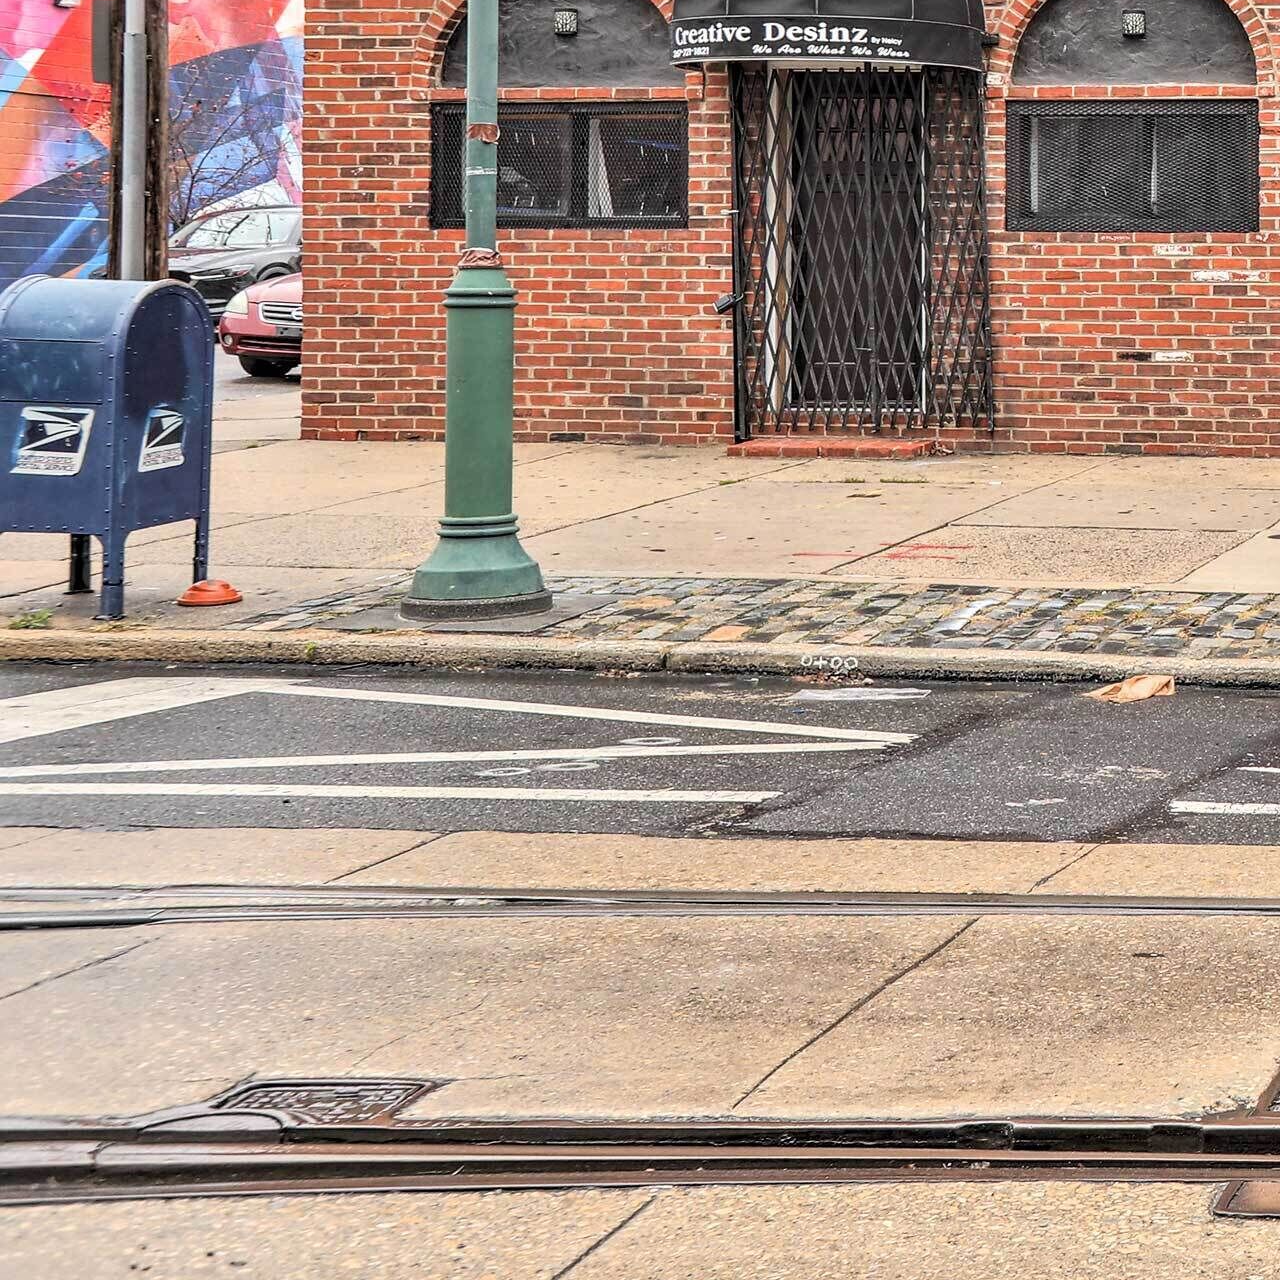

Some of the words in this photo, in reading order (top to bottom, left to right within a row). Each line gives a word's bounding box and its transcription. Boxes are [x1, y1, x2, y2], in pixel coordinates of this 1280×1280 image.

[675, 22, 752, 46] Creative
[762, 22, 868, 43] Desinz
[752, 44, 772, 54] We
[777, 44, 802, 54] Are
[806, 44, 847, 55] What
[851, 45, 873, 56] We
[876, 47, 910, 58] Wear
